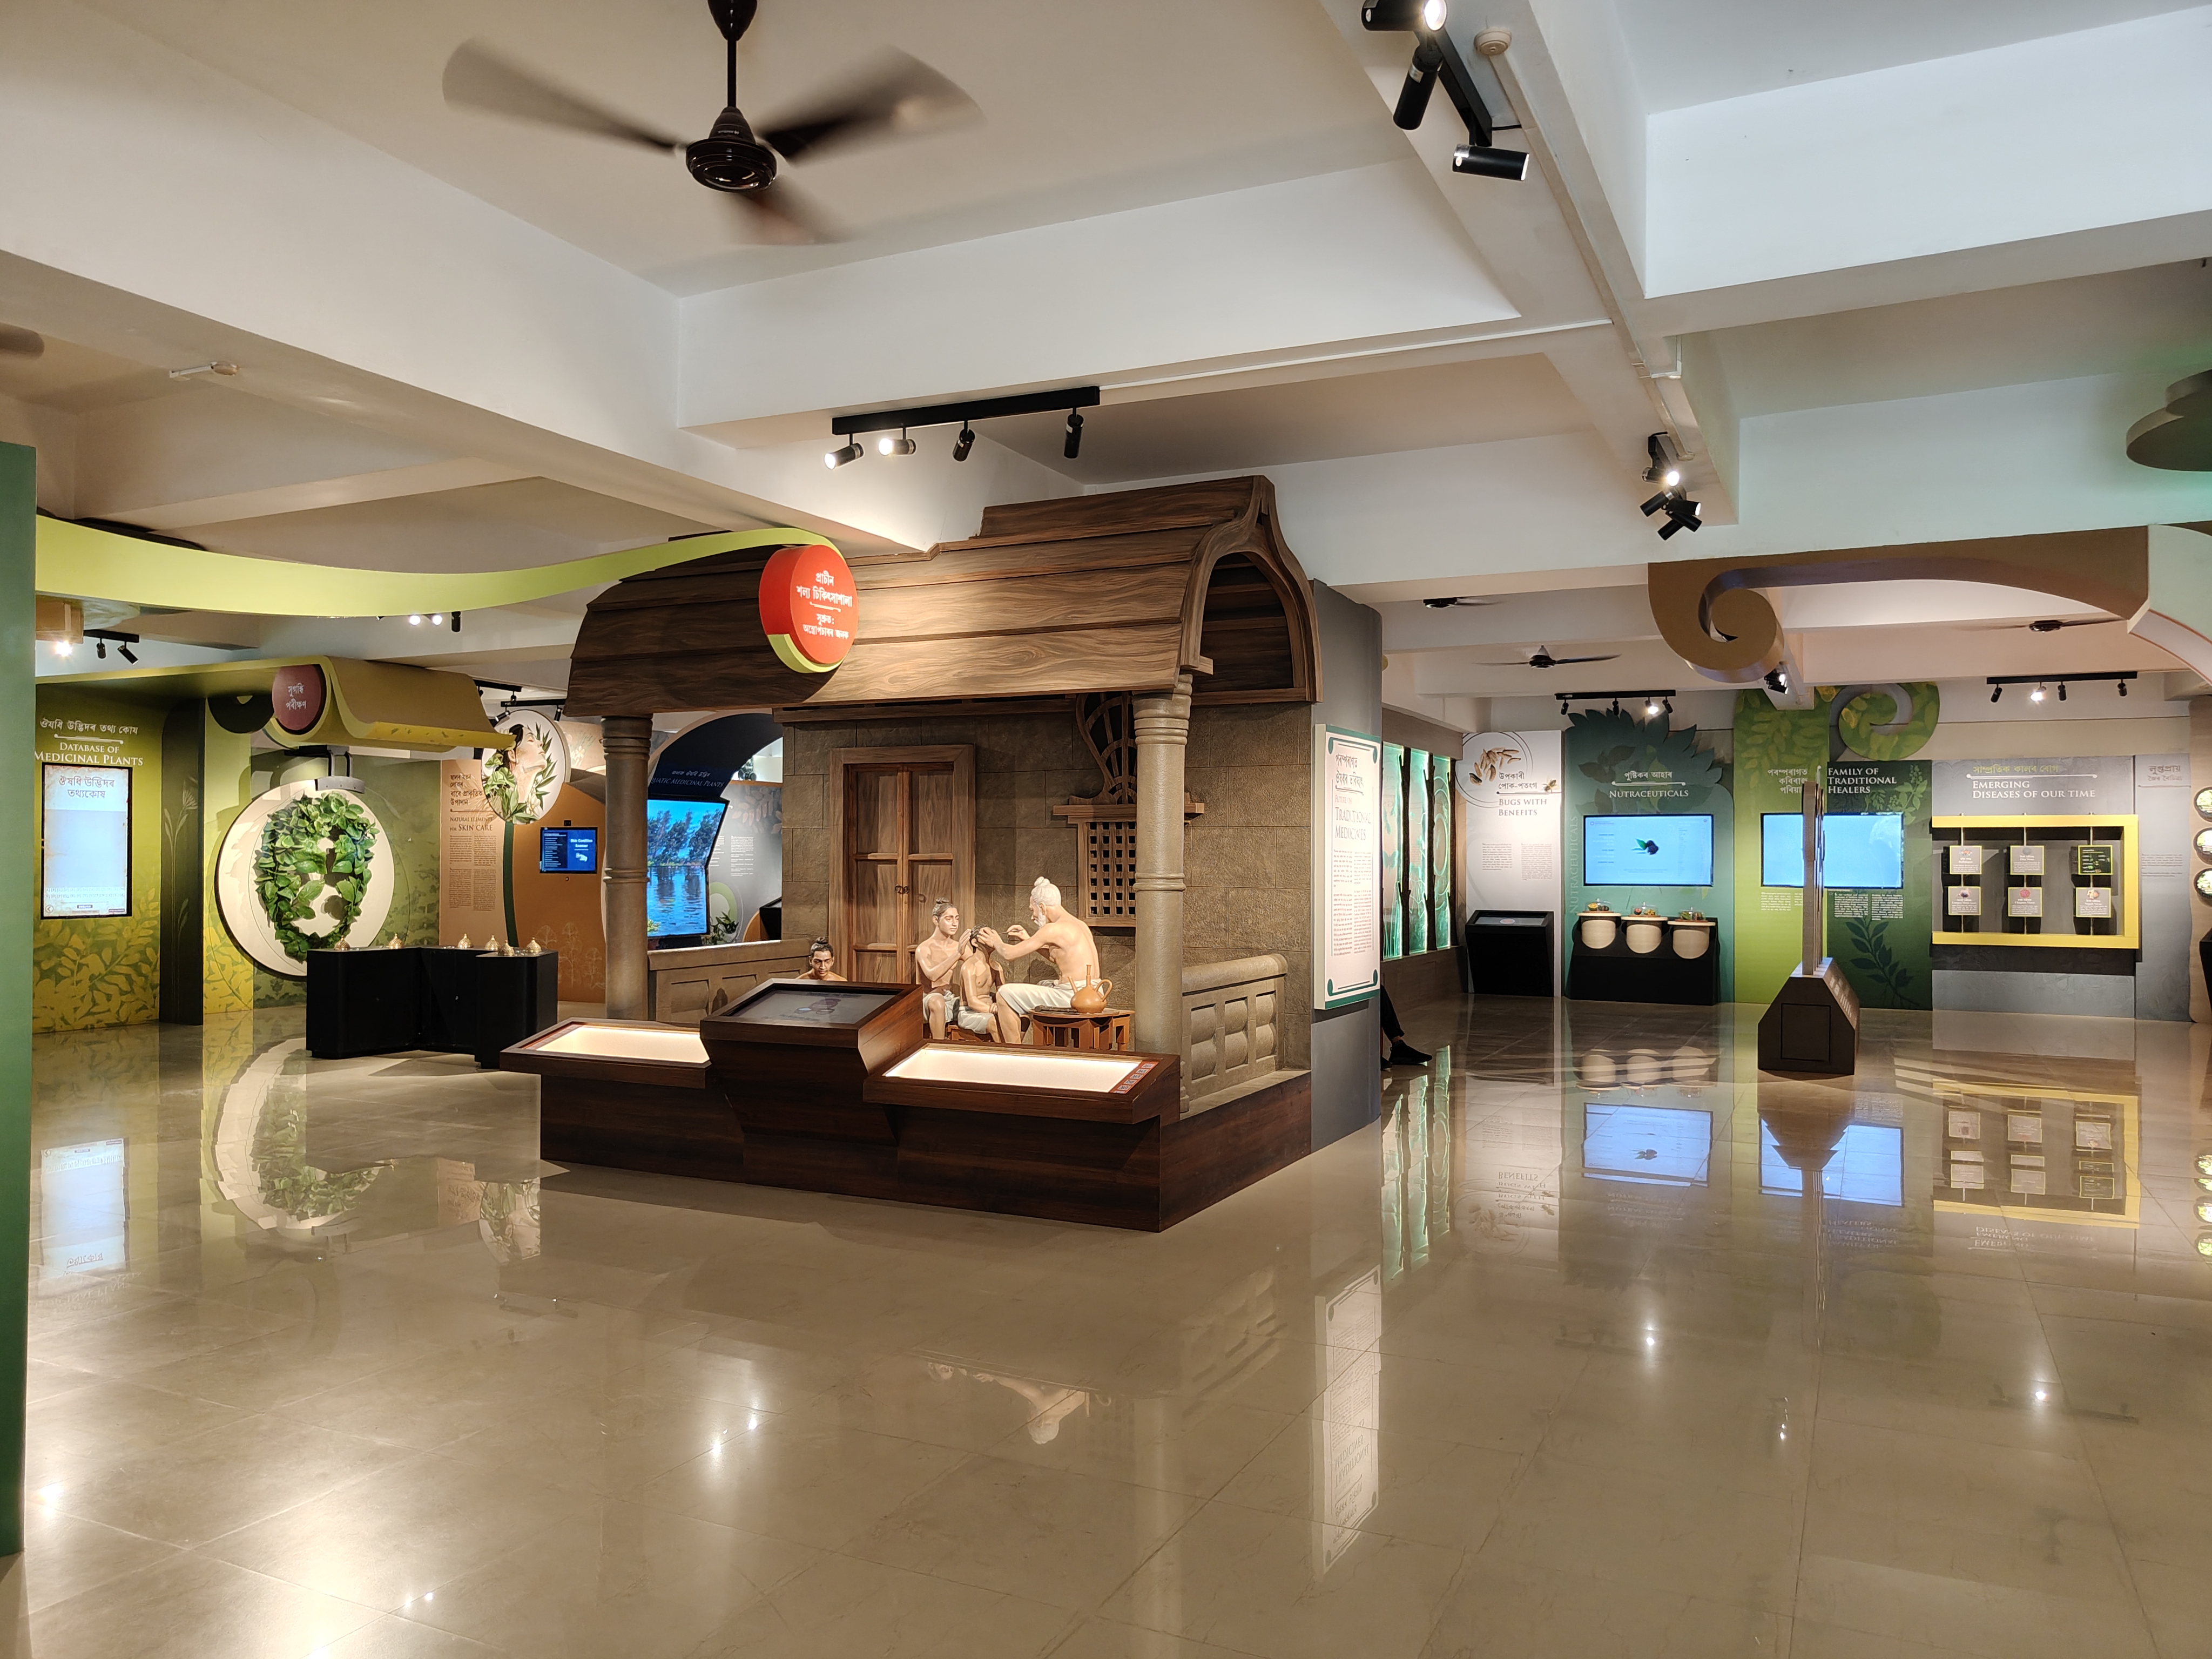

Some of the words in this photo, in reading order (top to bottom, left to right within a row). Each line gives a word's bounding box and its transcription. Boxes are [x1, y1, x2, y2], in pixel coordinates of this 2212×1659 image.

[59, 741, 105, 753] DATABASE
[35, 751, 100, 764] MEDICINAL
[103, 755, 143, 766] PLANTS
[1865, 767, 1879, 775] OF
[1827, 777, 1897, 785] TRADITIONAL
[1973, 781, 2029, 789] EMERGING
[1335, 807, 1371, 824] TRADITIONAL
[1335, 825, 1366, 840] MEDICINES
[1569, 815, 1579, 914] NUTRACEUTICALS
